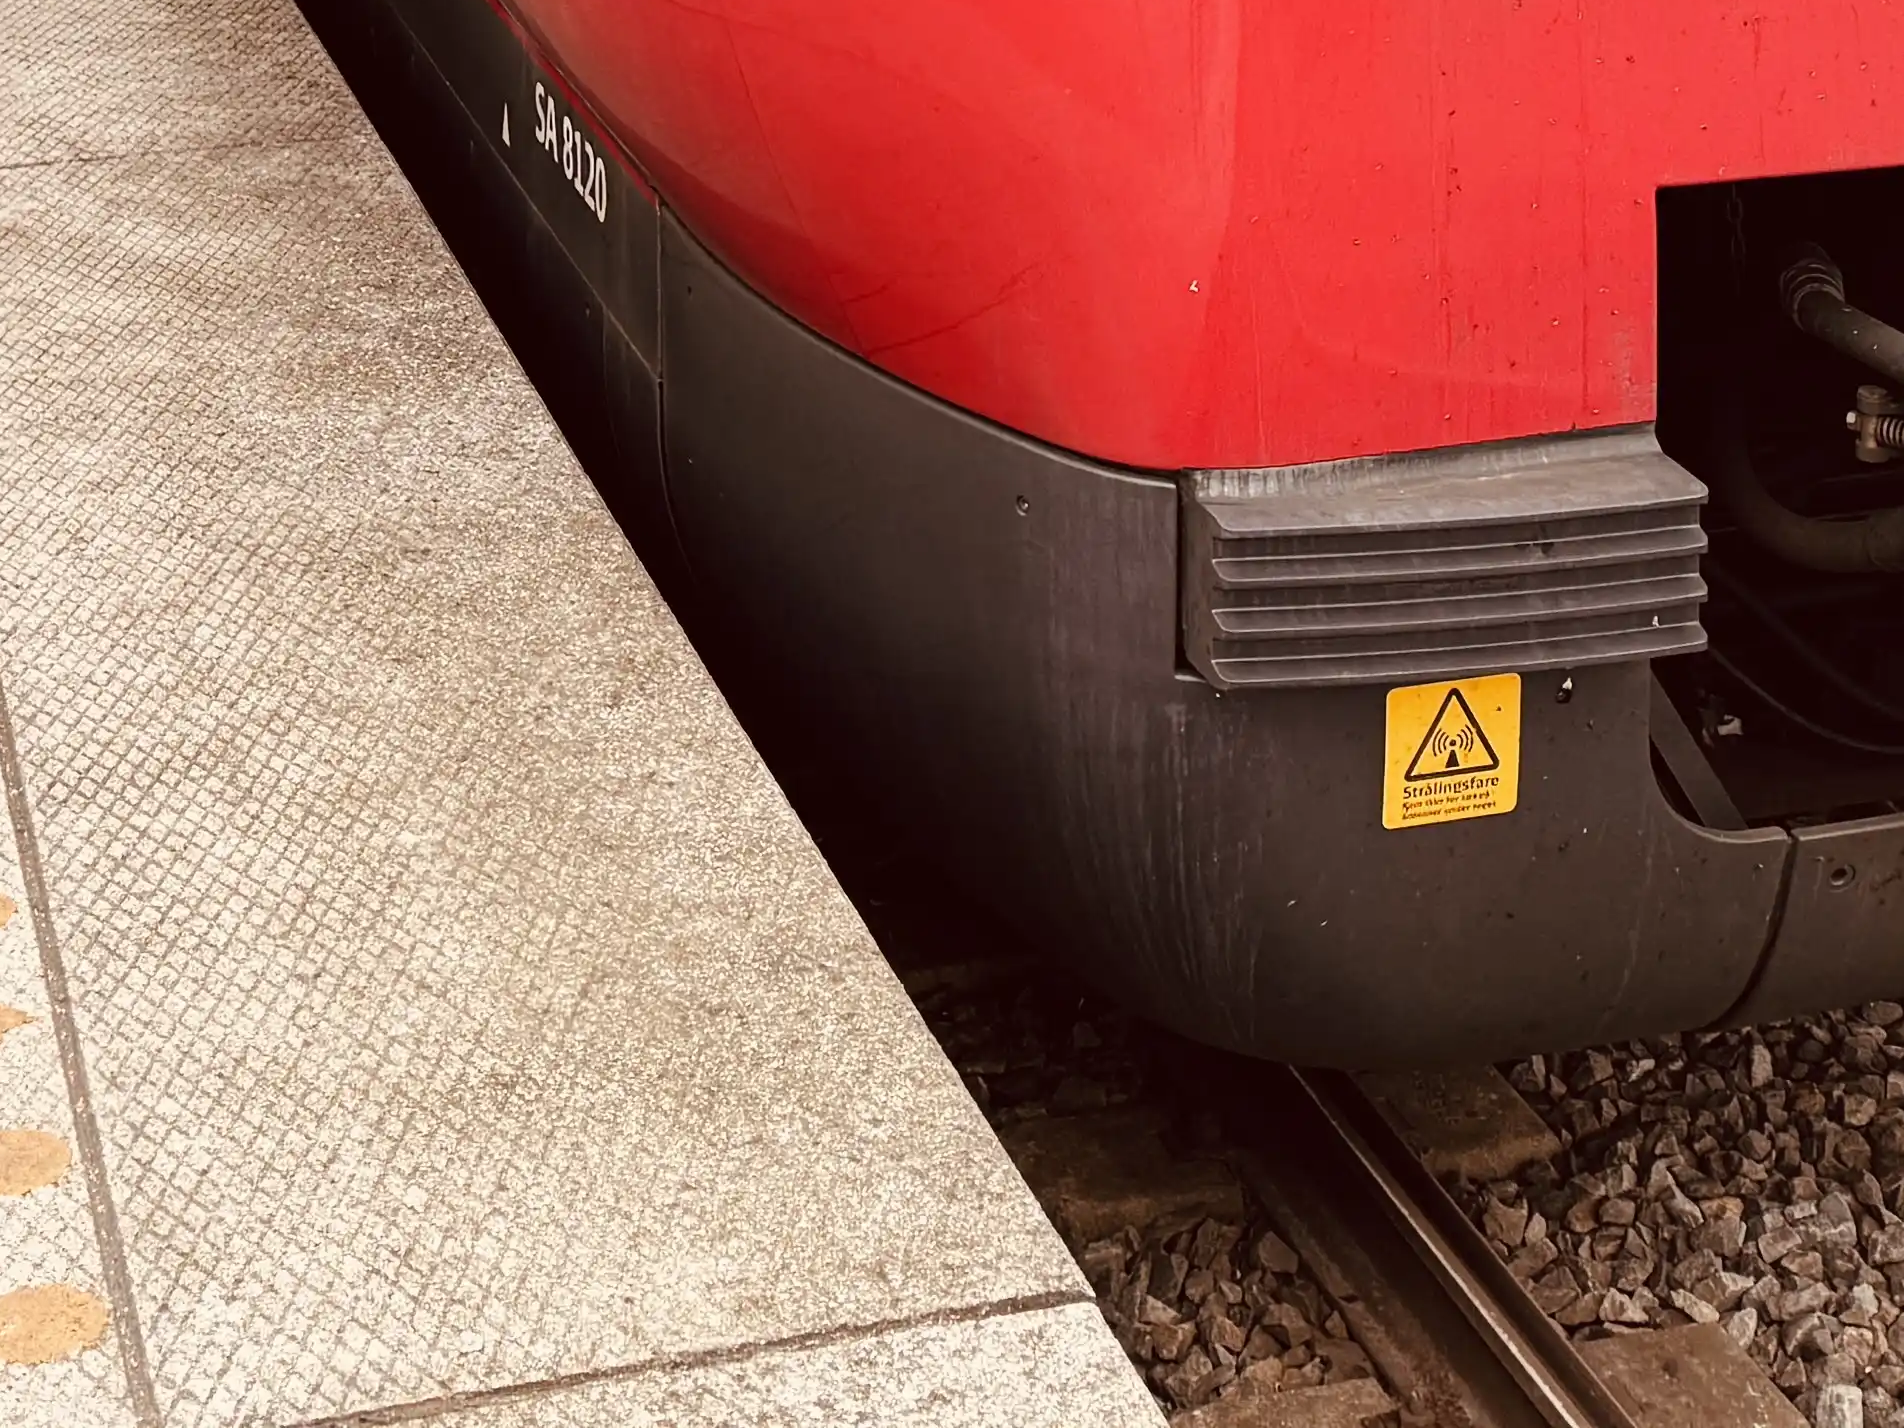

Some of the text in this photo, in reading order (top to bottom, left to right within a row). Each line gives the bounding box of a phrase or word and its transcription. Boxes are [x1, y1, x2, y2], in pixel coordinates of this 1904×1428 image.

[535, 81, 607, 223] SA 8120
[1403, 775, 1500, 800] Strålingsfare
